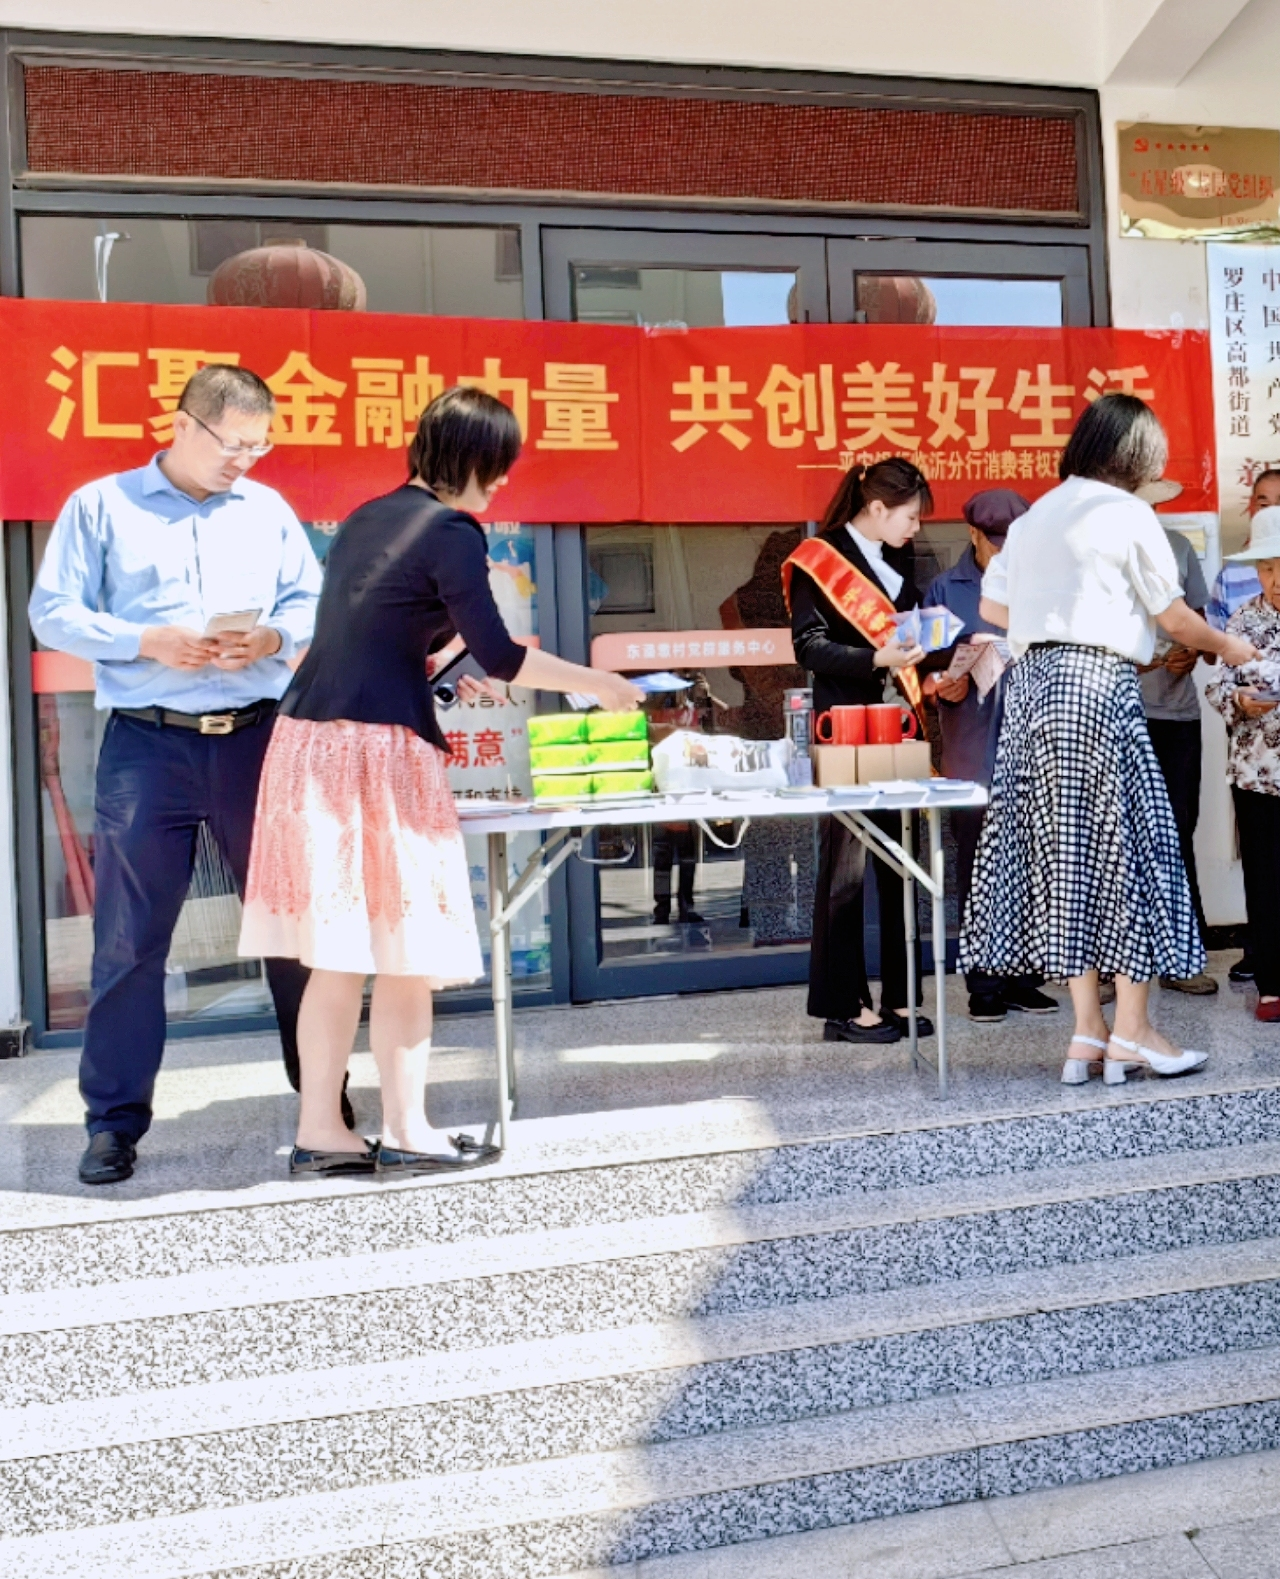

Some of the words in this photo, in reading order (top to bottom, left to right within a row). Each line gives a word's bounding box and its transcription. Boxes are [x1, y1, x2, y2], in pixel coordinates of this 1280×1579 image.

[1223, 266, 1251, 437] 罗庄区高都街道
